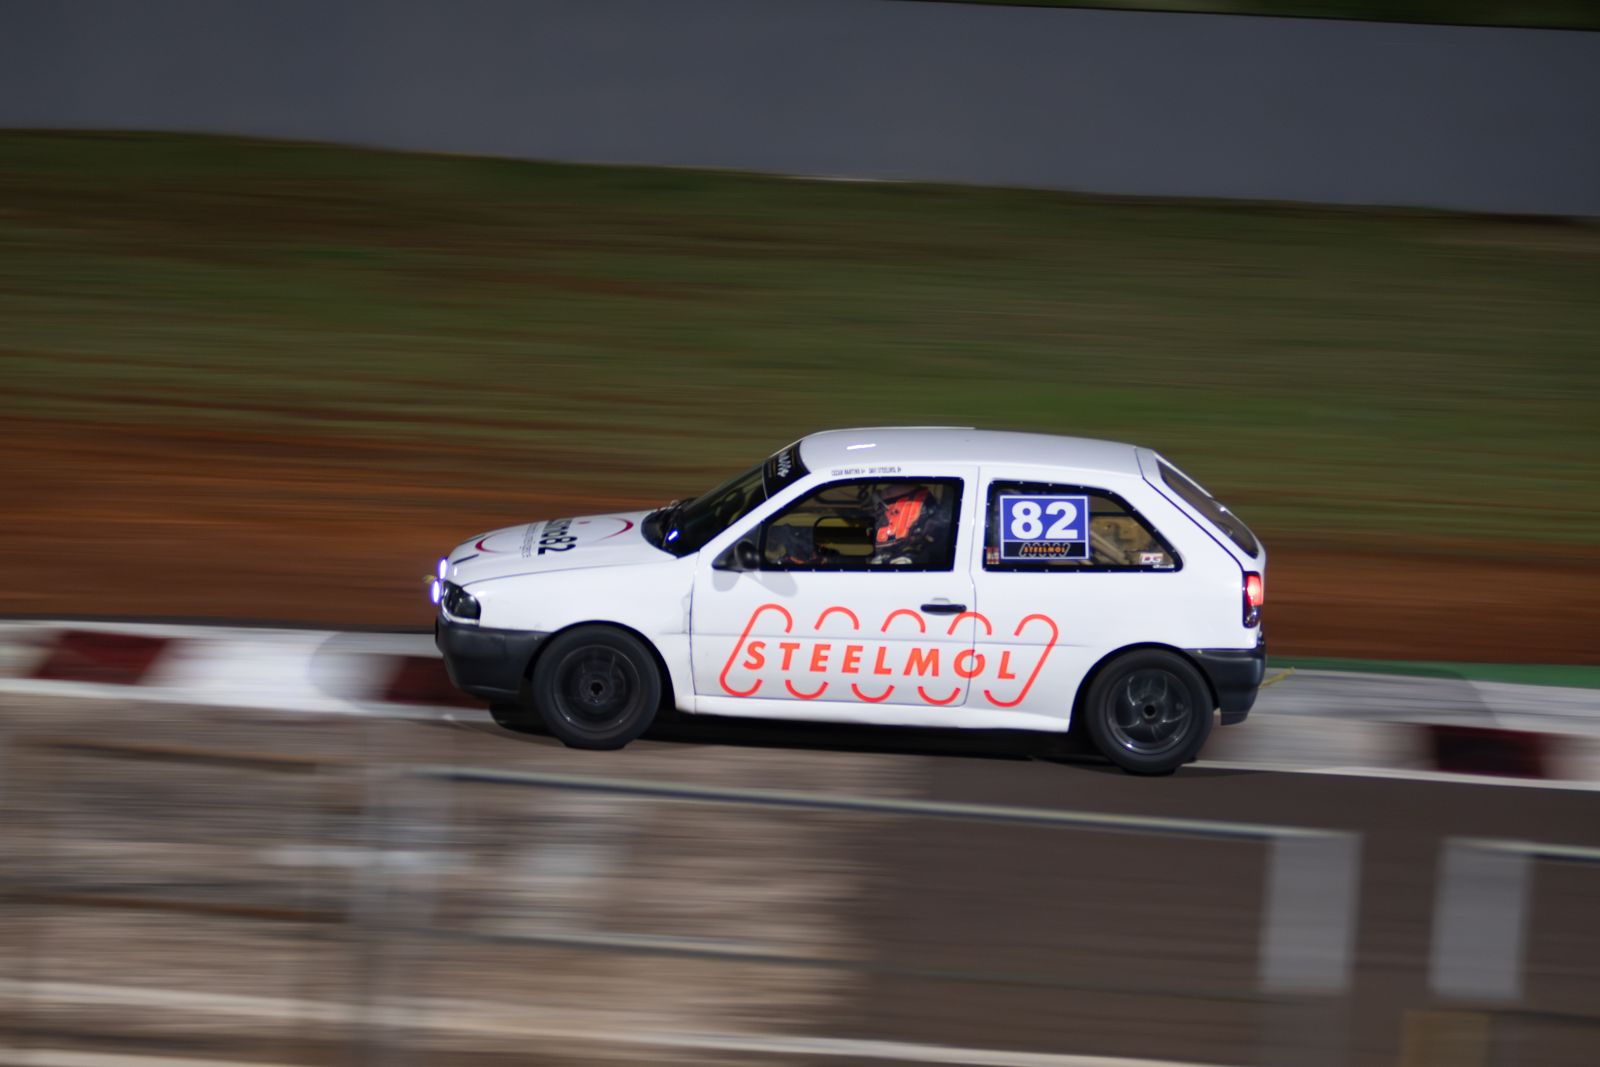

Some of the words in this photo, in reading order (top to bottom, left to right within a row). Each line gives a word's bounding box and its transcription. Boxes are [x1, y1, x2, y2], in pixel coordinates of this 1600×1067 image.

[1010, 501, 1078, 539] 82
[1024, 546, 1066, 554] STEELMOL
[742, 640, 1017, 679] STEELMOL
